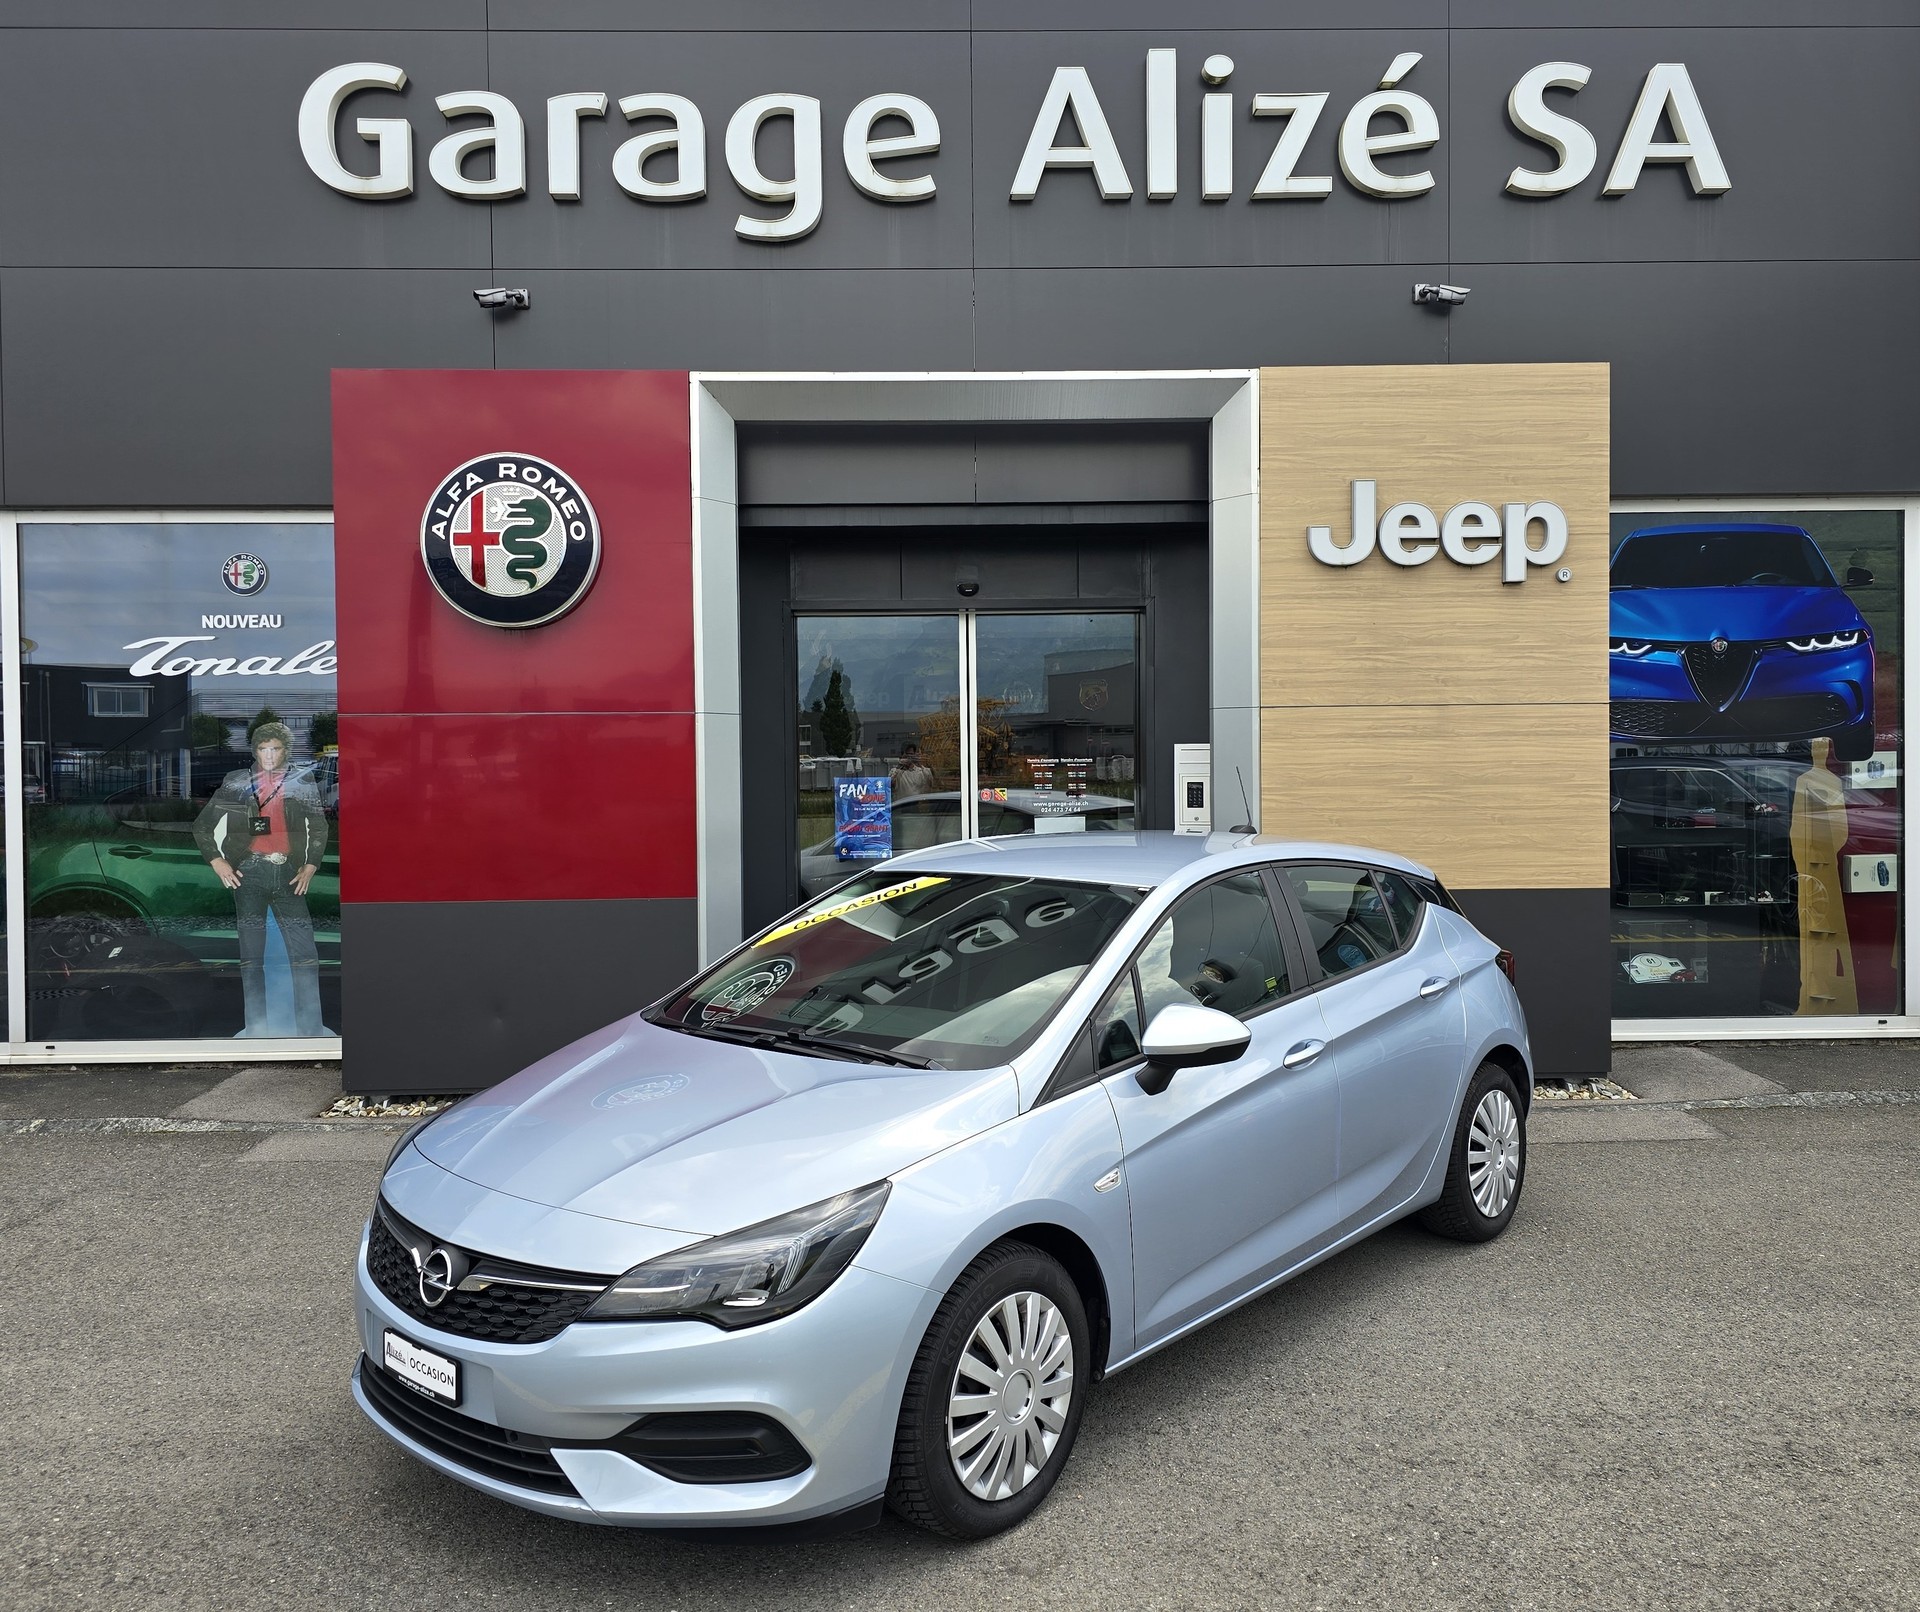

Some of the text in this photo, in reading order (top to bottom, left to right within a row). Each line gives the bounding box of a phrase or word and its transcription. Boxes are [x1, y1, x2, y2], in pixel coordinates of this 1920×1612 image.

[298, 48, 1734, 243] Garage Alizé SA
[431, 463, 587, 541] ALFA ROMEO
[1306, 478, 1569, 584] Jeep
[223, 555, 264, 575] ALFA ROMEO
[201, 614, 283, 629] NOUVEAU
[122, 635, 338, 677] Tonale
[839, 783, 867, 798] FAN
[793, 882, 917, 930] OCCASION
[941, 1283, 995, 1366] KUMHO
[386, 1341, 403, 1359] Alizé
[409, 1357, 454, 1387] OCCASION
